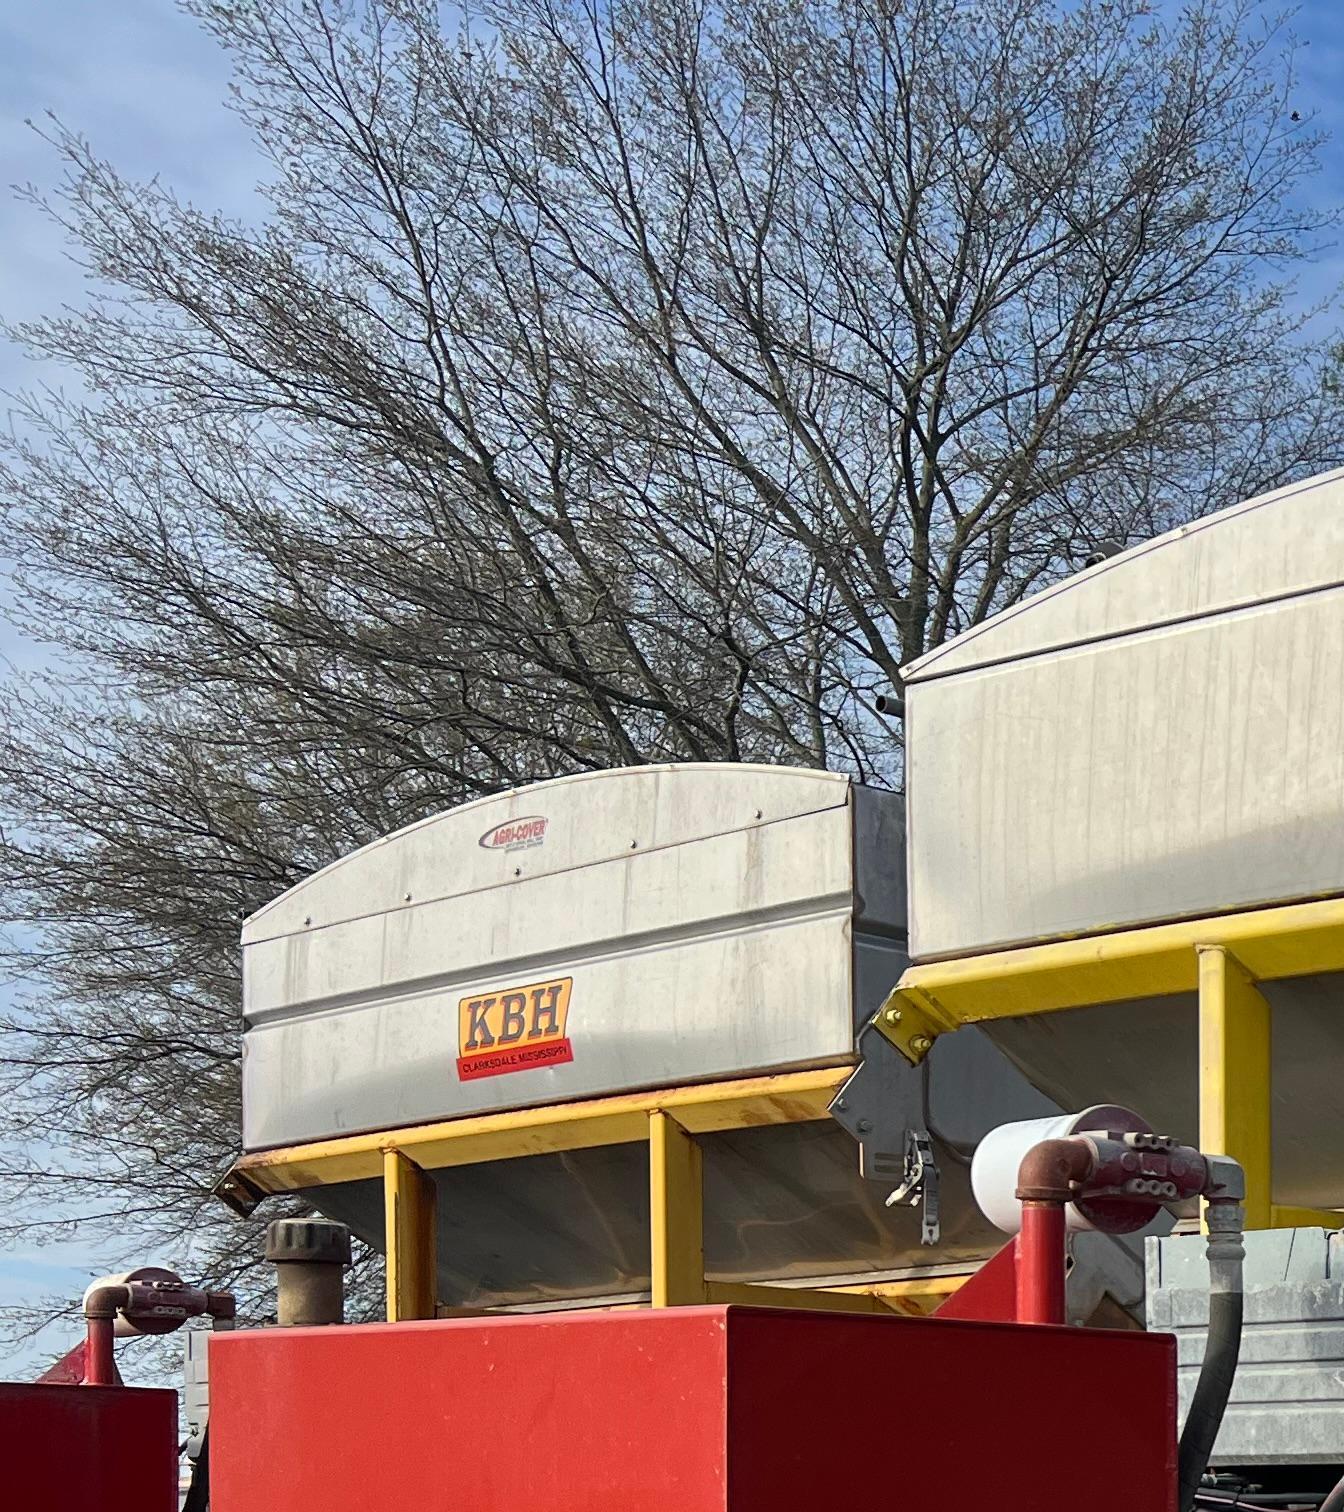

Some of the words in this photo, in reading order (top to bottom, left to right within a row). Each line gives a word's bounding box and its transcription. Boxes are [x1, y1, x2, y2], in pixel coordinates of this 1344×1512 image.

[492, 820, 545, 846] AGRI-COVER
[464, 984, 563, 1052] KBH
[518, 1046, 567, 1063] MISSISSIPPI
